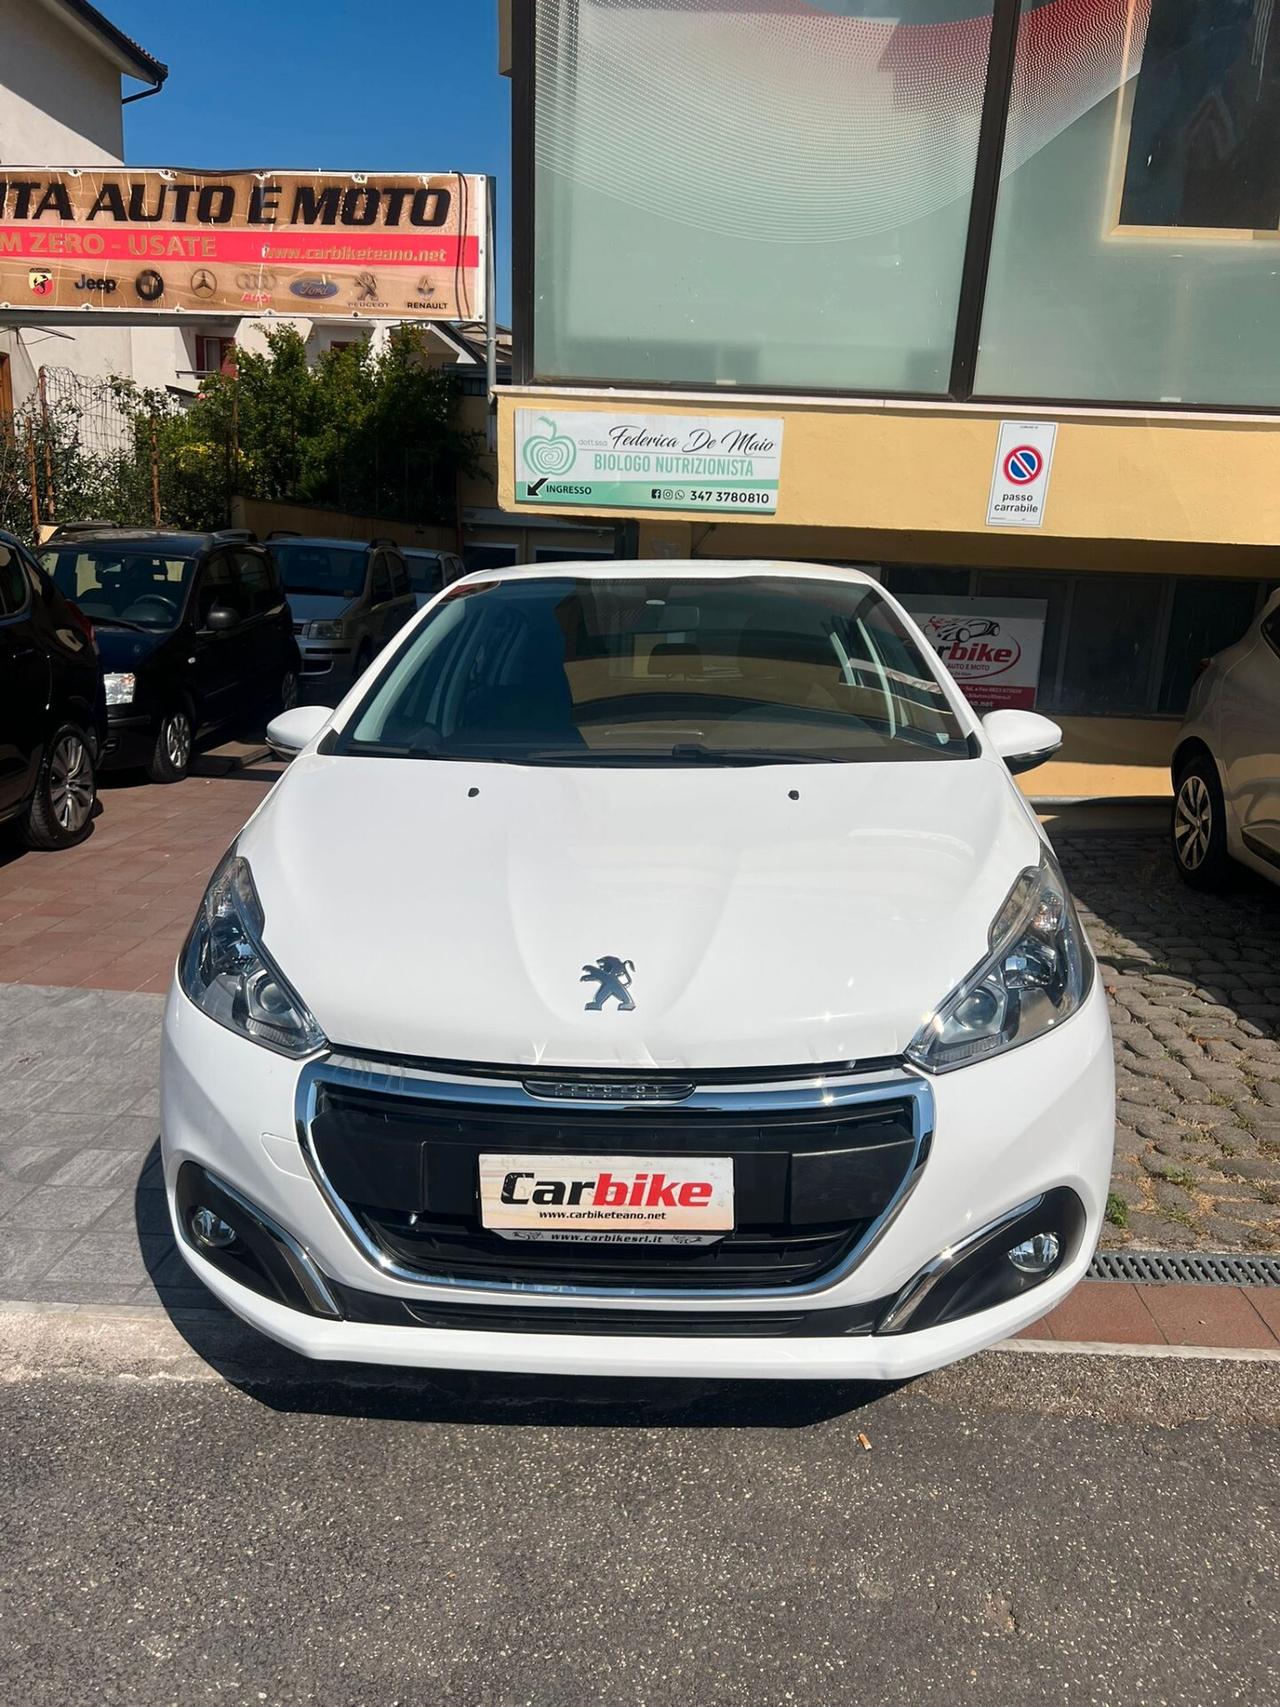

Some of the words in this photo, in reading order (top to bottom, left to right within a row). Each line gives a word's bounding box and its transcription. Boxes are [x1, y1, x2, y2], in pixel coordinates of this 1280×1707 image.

[86, 184, 235, 223] AUTO
[247, 186, 282, 224] E
[290, 187, 451, 227] MOTO
[28, 231, 104, 254] ZERO
[128, 234, 217, 257] USATE
[262, 245, 447, 262] www.carbiketeano.net
[75, 274, 116, 293] Jeep
[299, 280, 330, 295] Ford
[407, 302, 448, 310] RENAULT
[608, 425, 681, 450] Federica
[682, 428, 717, 453] De
[720, 429, 775, 456] Maio
[594, 453, 651, 473] BIOLOGO
[655, 456, 754, 477] NUTRIZIONISTA
[546, 484, 592, 495] INGRESSO
[690, 490, 711, 502] 347
[716, 491, 770, 504] 3780810
[1002, 493, 1034, 502] passo
[994, 503, 1039, 513] carrabile
[933, 641, 1012, 663] rbike
[500, 1171, 713, 1207] Carbike
[539, 1209, 667, 1221] www.carbiketeano.net
[551, 1232, 663, 1244] www.carbikesrl.it
